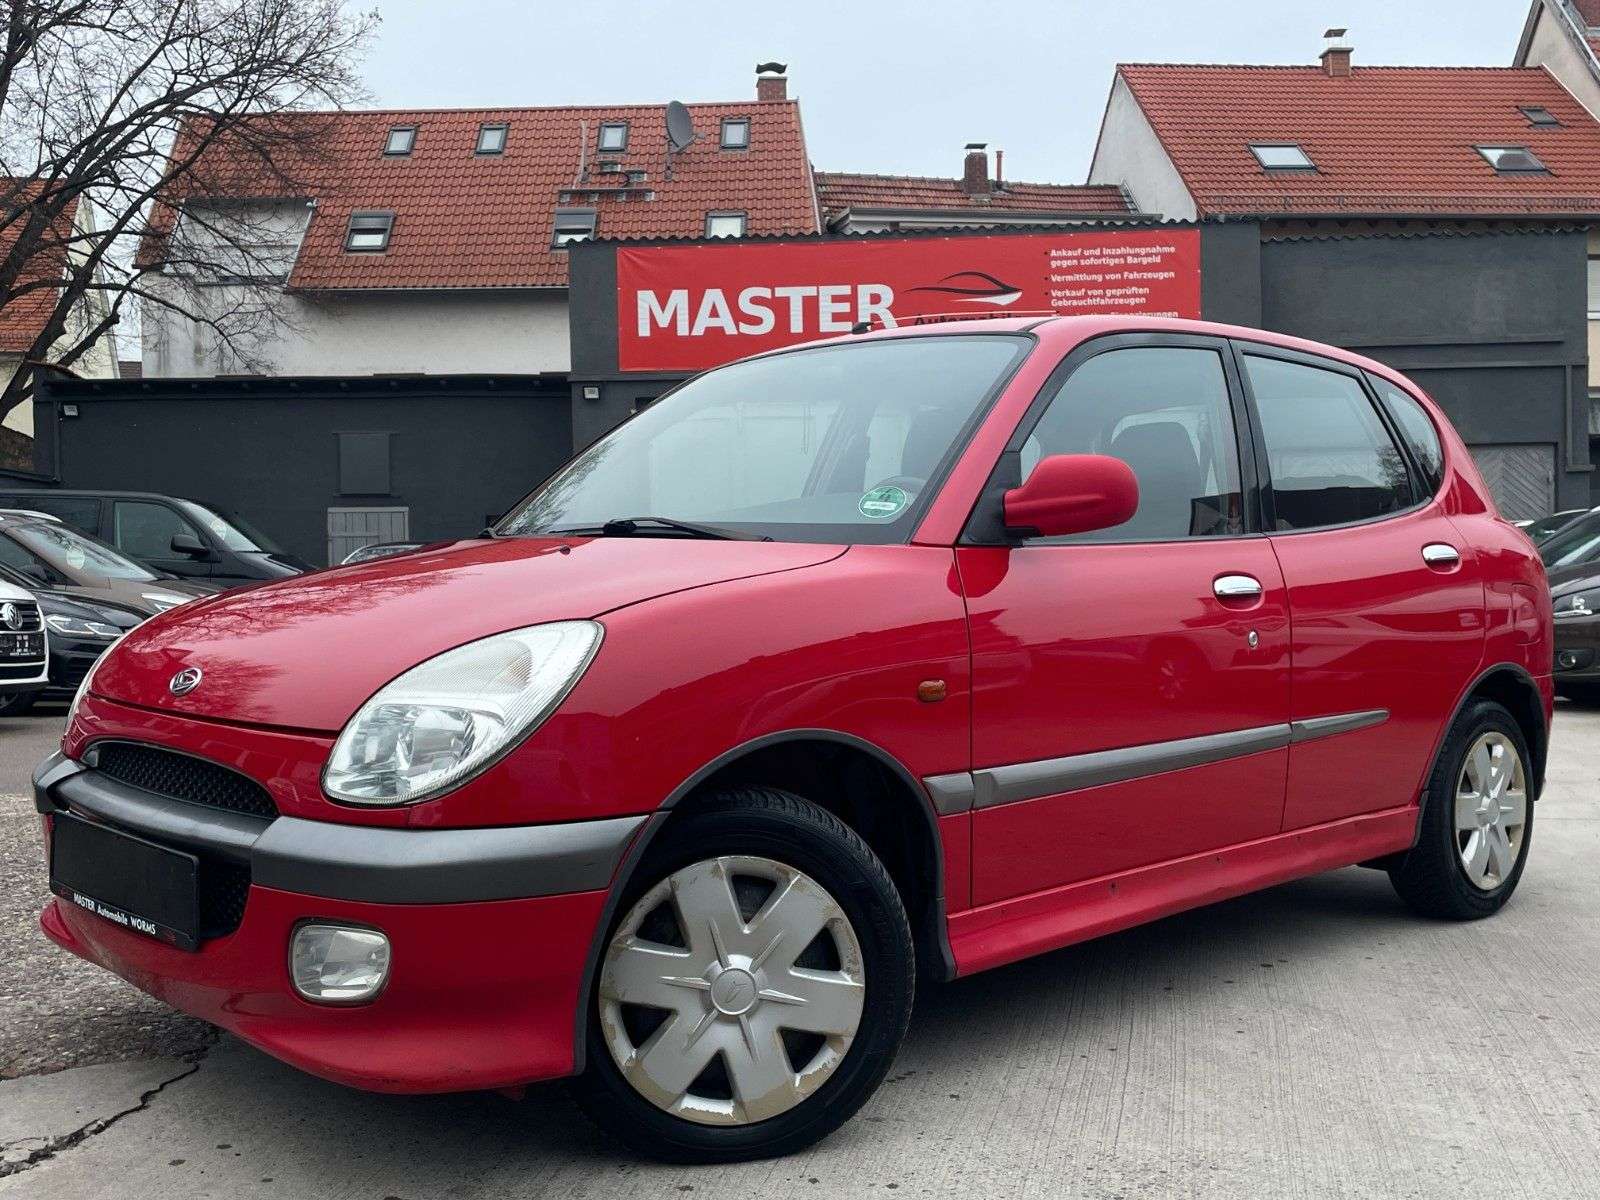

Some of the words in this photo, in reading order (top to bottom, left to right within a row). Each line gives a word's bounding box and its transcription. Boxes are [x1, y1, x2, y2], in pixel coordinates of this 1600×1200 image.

[1050, 248, 1082, 257] Ankauf
[1084, 247, 1101, 256] und
[1102, 245, 1176, 256] Inzahlungnahme
[1050, 259, 1078, 268] gegen
[1080, 257, 1125, 266] sofortiges
[1126, 255, 1161, 265] Bargeld
[1050, 273, 1103, 282] Vermittlung
[1104, 272, 1121, 280] von
[1123, 271, 1176, 280] Fahrzeugen
[1050, 288, 1086, 297] Verkauf
[1105, 286, 1150, 297] geprüften
[1050, 297, 1146, 307] Gebrauchtfahrzeugen
[636, 283, 899, 337] MASTER
[73, 892, 96, 912] MASTER
[97, 904, 128, 926] Automobile
[130, 916, 156, 935] WORMS
